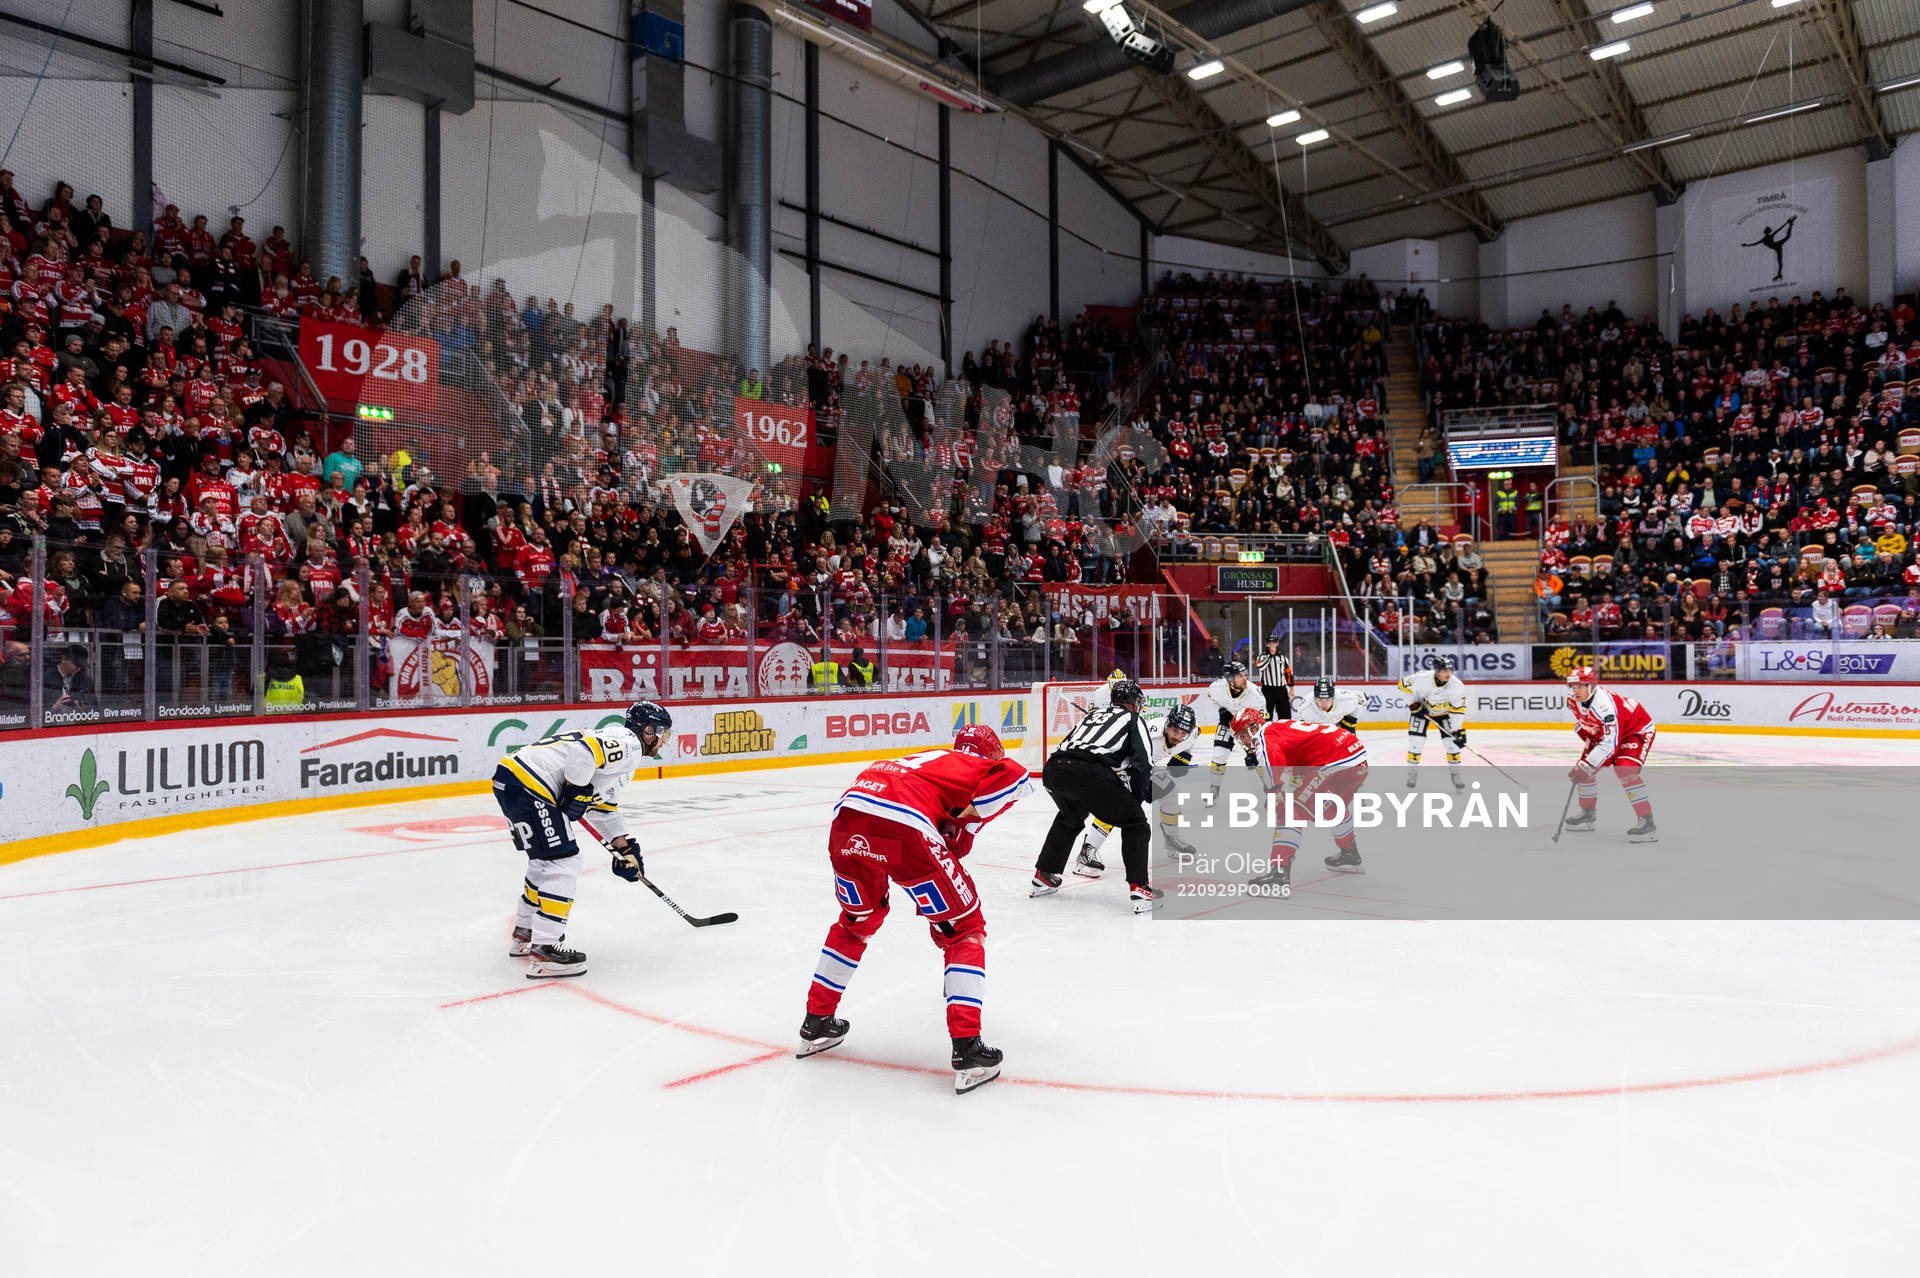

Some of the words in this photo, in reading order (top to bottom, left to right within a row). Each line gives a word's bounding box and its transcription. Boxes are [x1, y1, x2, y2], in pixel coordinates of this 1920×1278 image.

[1757, 191, 1787, 203] TIMRÅ
[315, 333, 428, 384] 1928
[742, 411, 808, 448] 1962
[1223, 571, 1274, 580] GRÖNSAKS
[1237, 580, 1266, 588] HUSET
[1403, 648, 1517, 672] Rönnes
[1759, 650, 1823, 671] L&S
[1839, 654, 1882, 674] golv
[588, 653, 749, 701] RÄTTA
[103, 708, 119, 718] Give
[120, 707, 142, 718] aways
[214, 703, 253, 714] Ljusskyltar
[1678, 689, 1731, 718] Diös
[714, 709, 764, 734] EURO
[826, 711, 931, 739] BORGA
[1086, 711, 1113, 725] 33
[1846, 715, 1893, 724] Antonsson
[604, 739, 624, 763] 38
[700, 728, 776, 756] JACKPOT
[118, 739, 266, 796] LILIUM
[300, 751, 460, 790] Faradium
[119, 785, 266, 810] FASTIGHETER
